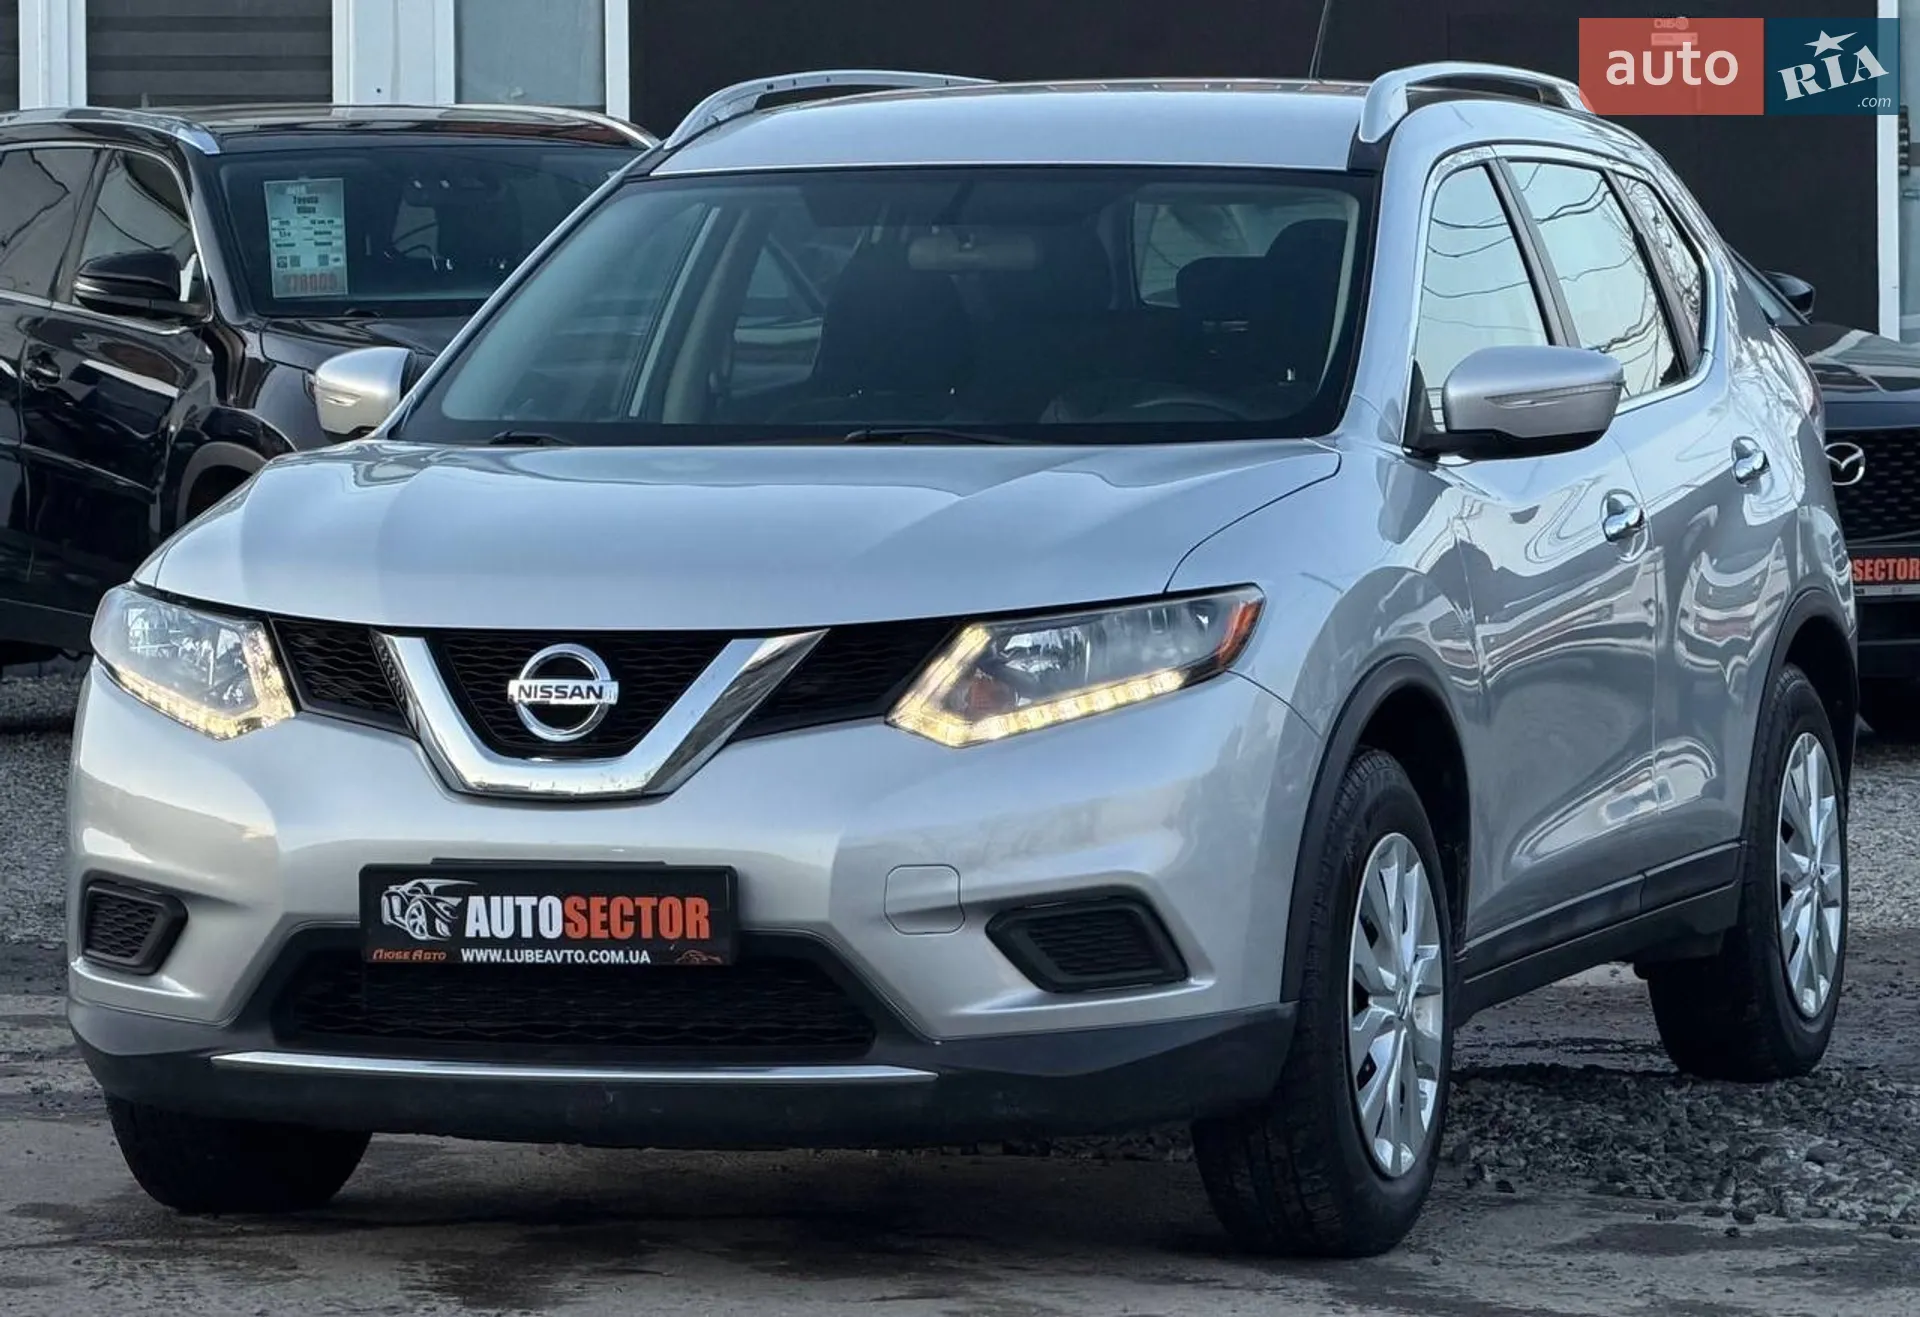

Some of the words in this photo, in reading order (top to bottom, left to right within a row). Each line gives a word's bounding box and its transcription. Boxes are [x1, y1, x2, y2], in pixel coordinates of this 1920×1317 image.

[518, 684, 604, 700] NISSAN
[465, 895, 710, 940] AUTOSECTOR
[461, 948, 651, 965] WWW.LUBEAVTO.COM.UA
